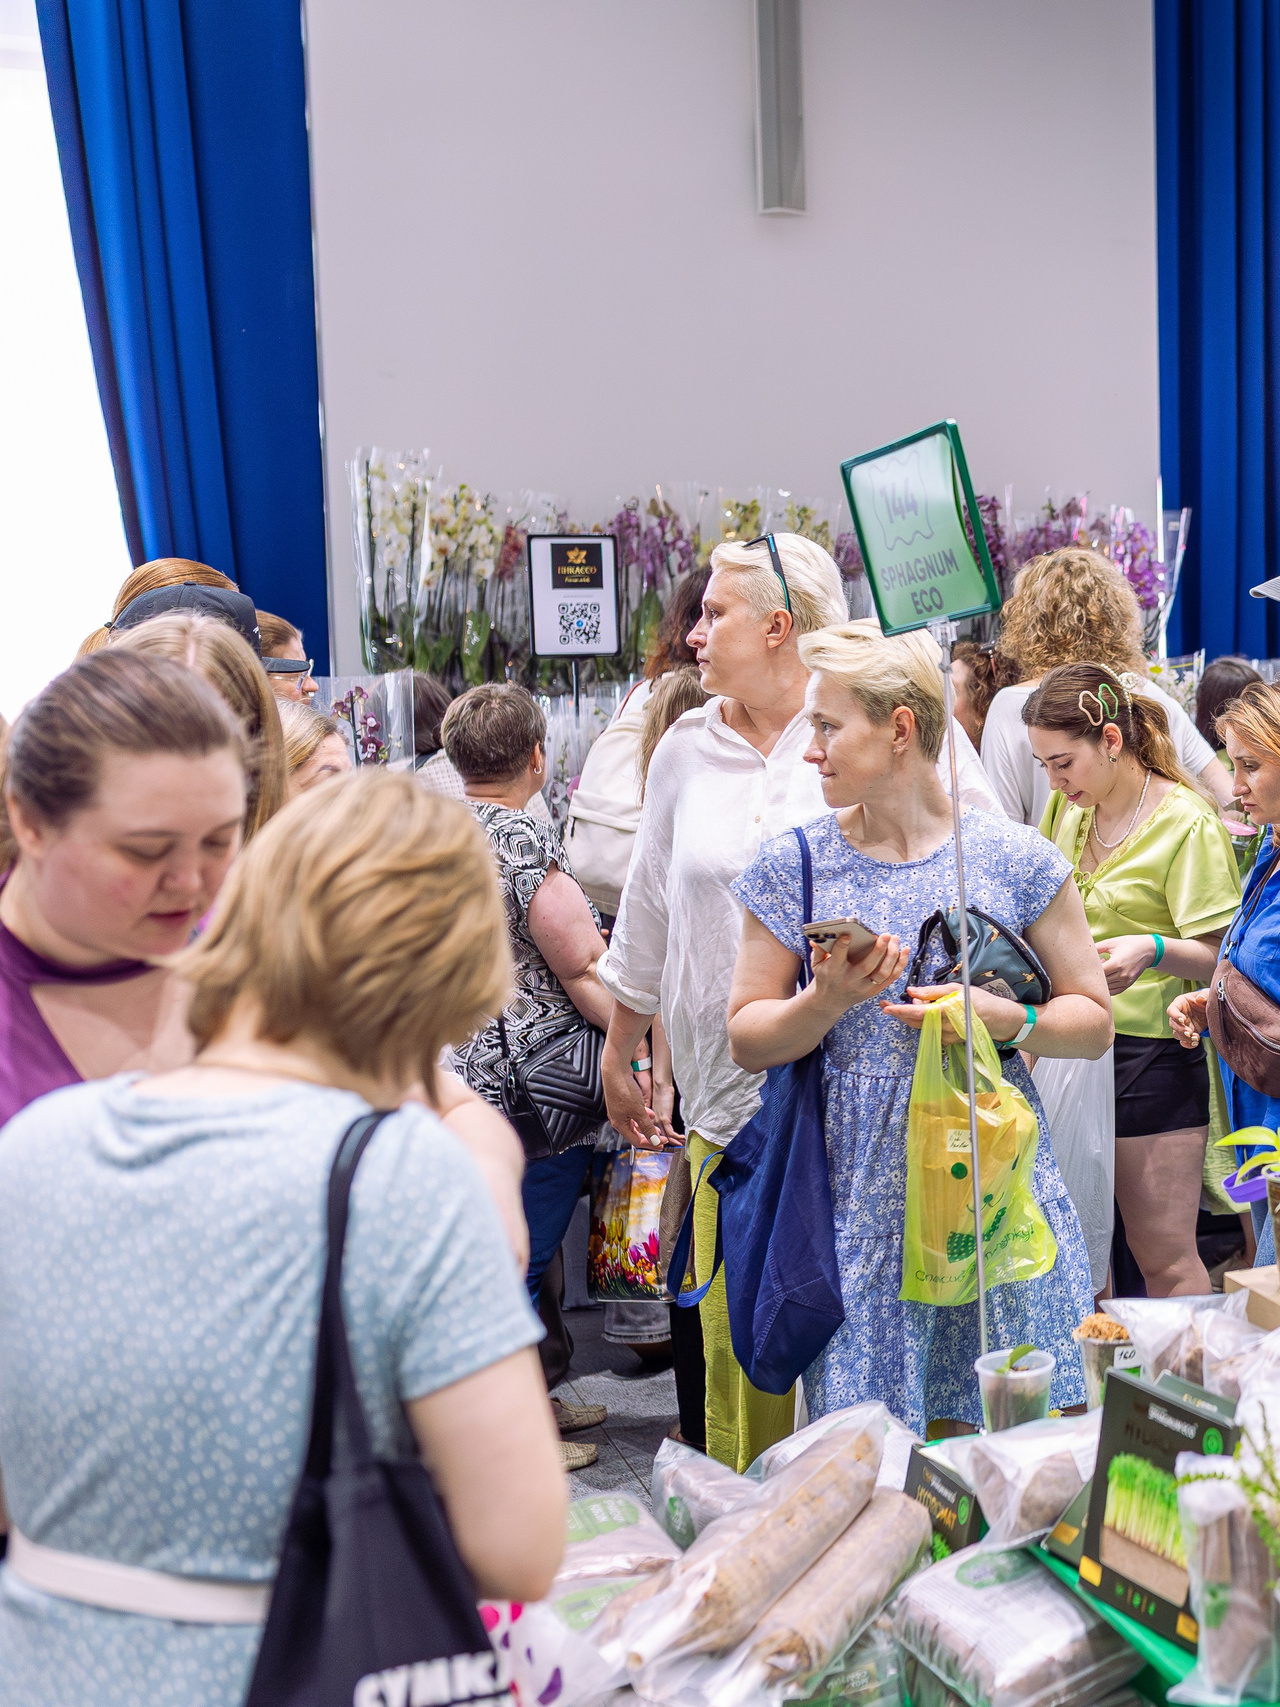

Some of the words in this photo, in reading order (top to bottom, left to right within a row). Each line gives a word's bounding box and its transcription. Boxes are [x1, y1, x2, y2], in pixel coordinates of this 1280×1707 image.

[879, 478, 919, 524] 144
[881, 549, 960, 591] SPHAGNUM
[911, 587, 944, 615] ECO
[353, 1650, 507, 1707] СУМК
